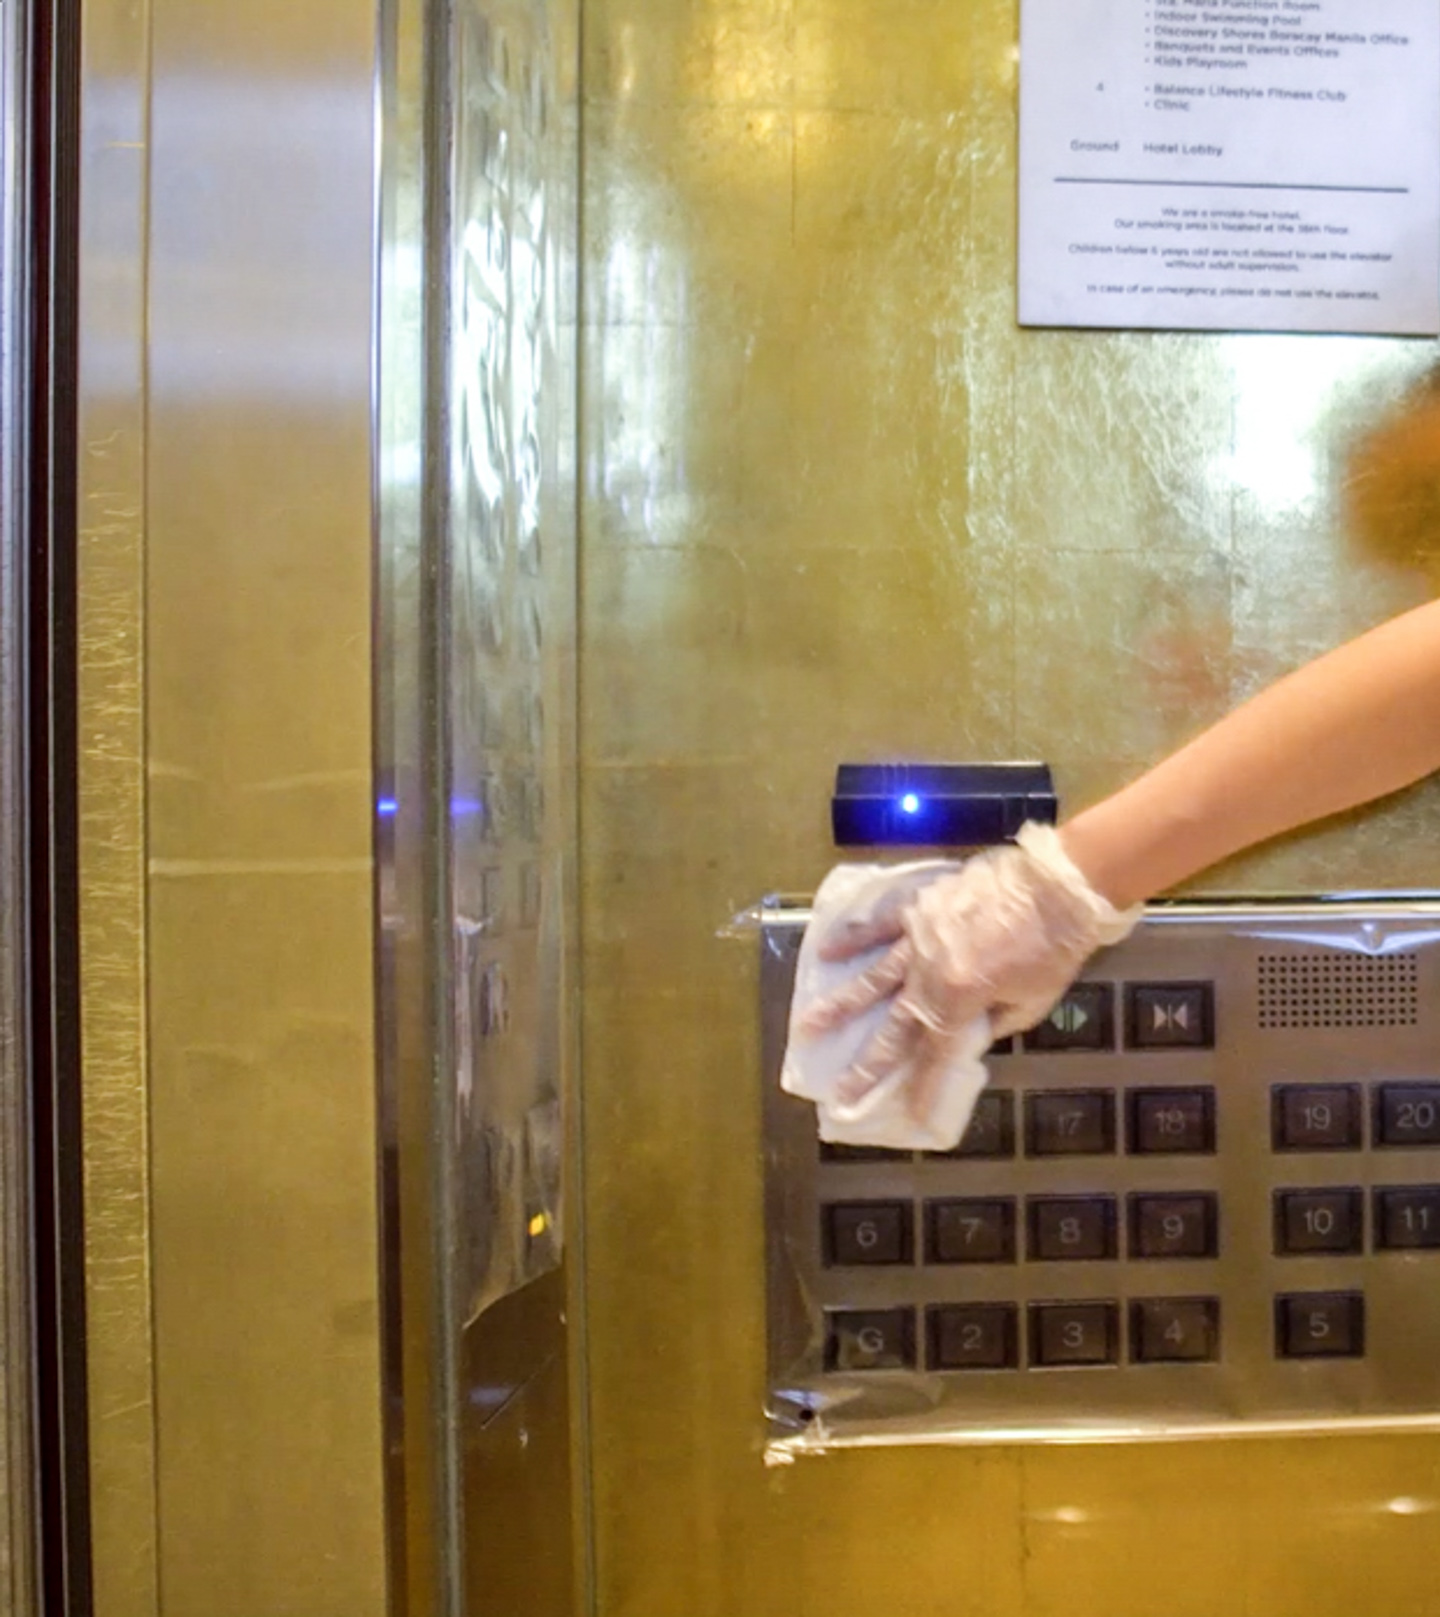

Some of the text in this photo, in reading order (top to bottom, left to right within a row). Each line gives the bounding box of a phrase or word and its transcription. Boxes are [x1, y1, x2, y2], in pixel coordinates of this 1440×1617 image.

[1282, 1, 1320, 11] Room
[1154, 11, 1301, 26] Indoor Swimming Pool
[1154, 25, 1409, 45] Discovery Shores Boracay Manila Office
[1154, 41, 1339, 58] Banquets and Events Offices
[1154, 56, 1247, 70] Kids Playroom
[1154, 83, 1206, 95] Balance
[1209, 85, 1264, 100] Lifestyle
[1267, 88, 1313, 99] Fitness
[1317, 90, 1346, 102] Club
[1154, 99, 1190, 111] Clinic
[1070, 139, 1223, 157] Ground Hotel Lobby
[1161, 208, 1179, 217] We
[1210, 209, 1269, 219] smoke-free
[1114, 218, 1134, 229] Our
[1137, 220, 1182, 231] smoking
[1185, 223, 1208, 231] area
[1221, 222, 1261, 232] located
[1277, 224, 1294, 233] the
[1068, 244, 1113, 254] Children
[1115, 245, 1148, 255] below
[1161, 248, 1189, 257] years
[1231, 249, 1249, 257] not
[1252, 250, 1292, 259] allowed
[1330, 251, 1347, 260] the
[1349, 252, 1392, 262] elevator
[1165, 259, 1205, 269] without
[1208, 260, 1235, 270] adult
[1100, 286, 1124, 294] case
[1126, 284, 1138, 294] of
[1220, 287, 1254, 297] please
[1275, 289, 1291, 298] not
[1315, 289, 1332, 299] the
[1059, 1111, 1083, 1135] 17
[1156, 1110, 1185, 1135] 18
[1304, 1106, 1330, 1131] 19
[1397, 1103, 1435, 1129] 20
[856, 1220, 878, 1248] 6
[960, 1217, 983, 1244] 7
[1059, 1217, 1082, 1245] 8
[1162, 1214, 1185, 1240] 9
[1304, 1209, 1333, 1235] 10
[1403, 1206, 1429, 1231] 11
[857, 1312, 1330, 1354] G 2 3 4 5
